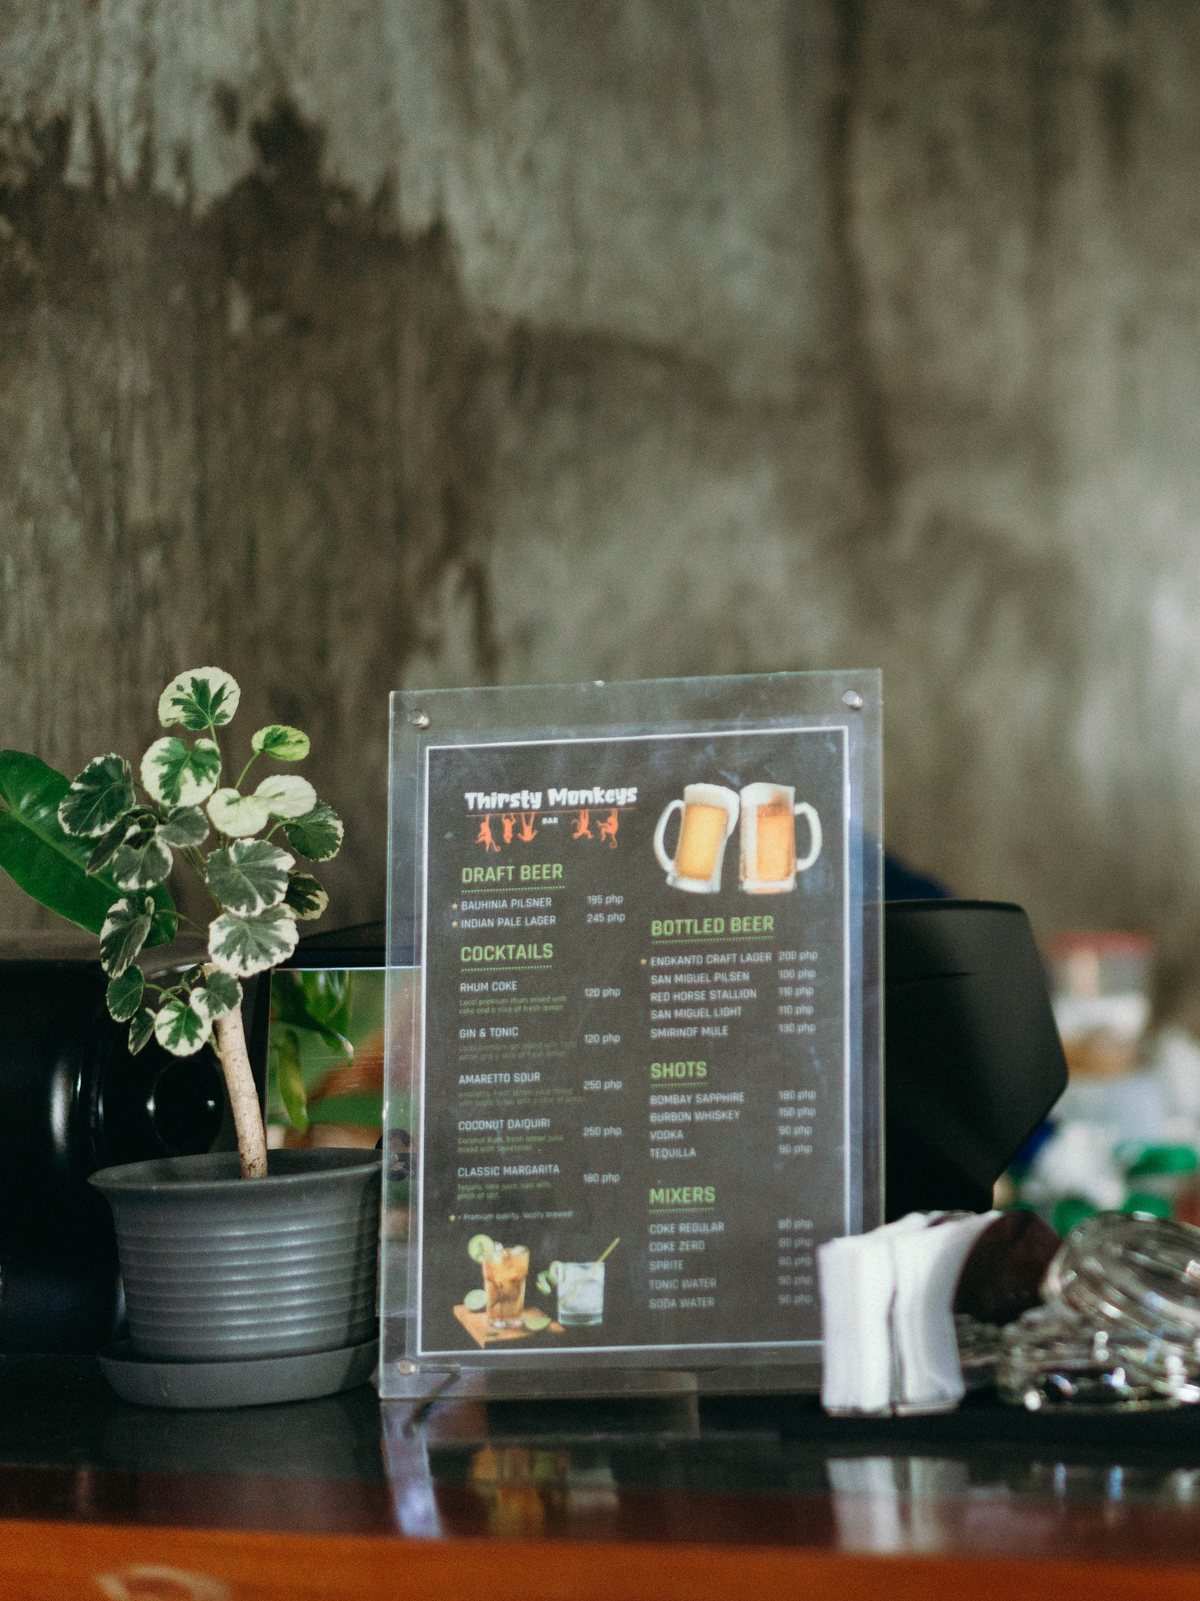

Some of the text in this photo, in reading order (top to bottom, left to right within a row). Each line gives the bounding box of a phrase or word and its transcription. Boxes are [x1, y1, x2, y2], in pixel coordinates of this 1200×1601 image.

[464, 787, 638, 810] Thirsty Monkeys
[461, 864, 563, 883] DRAFT BEER
[461, 898, 552, 911] BAUHINIA PILSNER
[605, 894, 624, 905] php
[461, 915, 557, 929] INDIAN PALE LAGER
[607, 913, 625, 923] php
[651, 915, 774, 936] BOTTLED BEER
[460, 943, 553, 962] COCKTAILS
[706, 953, 737, 964] CRAFT
[740, 952, 772, 962] LAGER
[800, 951, 818, 962] php
[651, 971, 750, 985] SAN MIGUEL PILSEN
[460, 981, 518, 992] RHUM COKE
[603, 987, 621, 999] php
[651, 988, 757, 1002] RED HORSE STALLION
[651, 1006, 742, 1020] SAN MIGUEL LIGHT
[459, 1026, 519, 1038] GIN & TONIC
[702, 1025, 729, 1036] MULE
[602, 1033, 621, 1044] php
[651, 1061, 707, 1079] SHOTS
[458, 1072, 540, 1085] AMARETTO SOUR
[604, 1080, 623, 1090] php
[650, 1092, 745, 1105] BOMBAY SAPPHIRE
[650, 1110, 741, 1122] BURBON WHISKEY
[458, 1118, 551, 1131] COCONUT DAIQUIRI
[604, 1126, 622, 1137] php
[650, 1129, 684, 1140] VODKA
[650, 1148, 696, 1160] TEQUILLA
[458, 1164, 560, 1177] CLASSIC MARGARITA
[602, 1173, 620, 1184] php
[650, 1186, 716, 1203] MIXERS
[649, 1222, 725, 1234] COKE REGULAR
[649, 1240, 705, 1252] COKE ZERO
[649, 1260, 684, 1271] SPRITE
[649, 1278, 717, 1290] TONIC WATER
[649, 1298, 677, 1309] SODA
